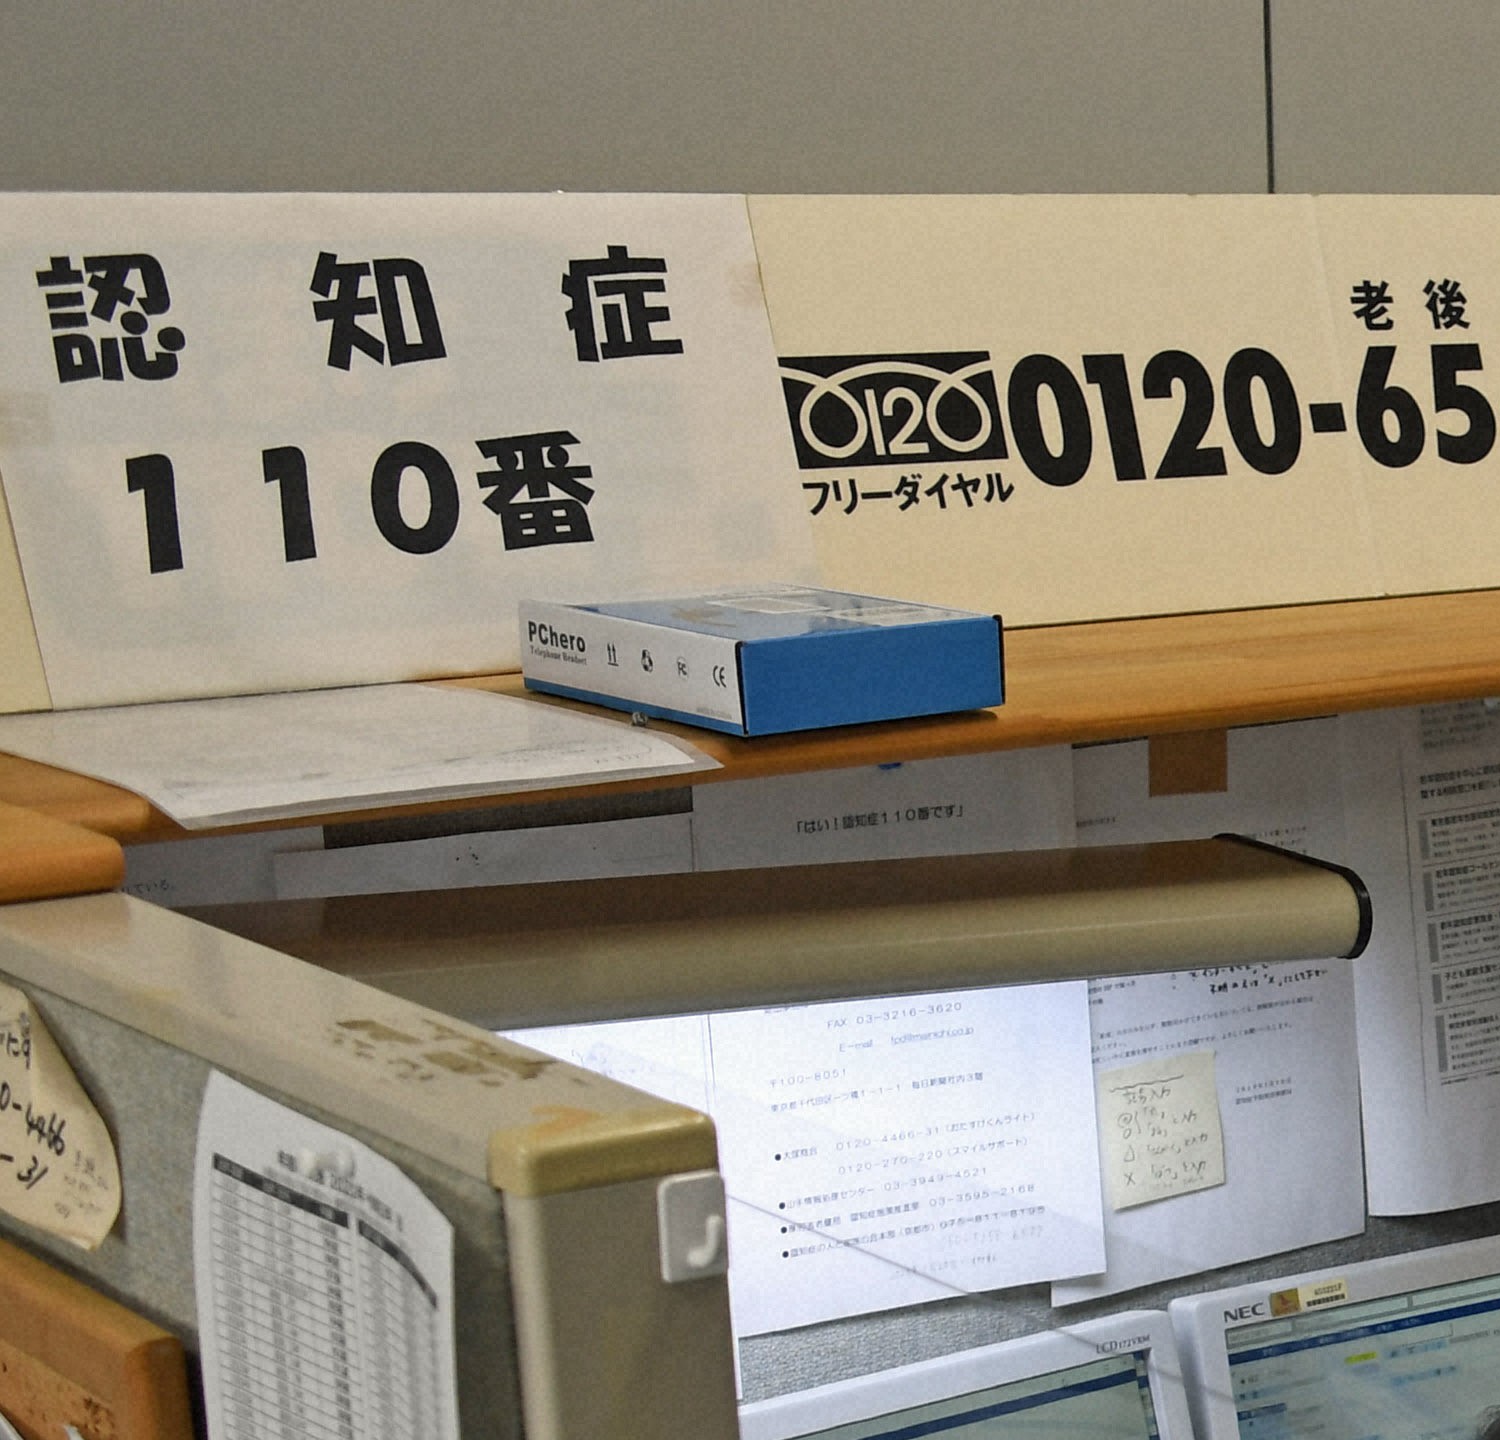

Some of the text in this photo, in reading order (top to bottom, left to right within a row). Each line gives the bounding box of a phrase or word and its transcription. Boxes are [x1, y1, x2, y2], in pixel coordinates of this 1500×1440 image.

[36, 245, 684, 383] 認知症
[126, 430, 596, 575] 110番
[803, 473, 1015, 515] フリーダイヤル
[528, 621, 586, 652] PChero
[1224, 1302, 1265, 1323] NEC
